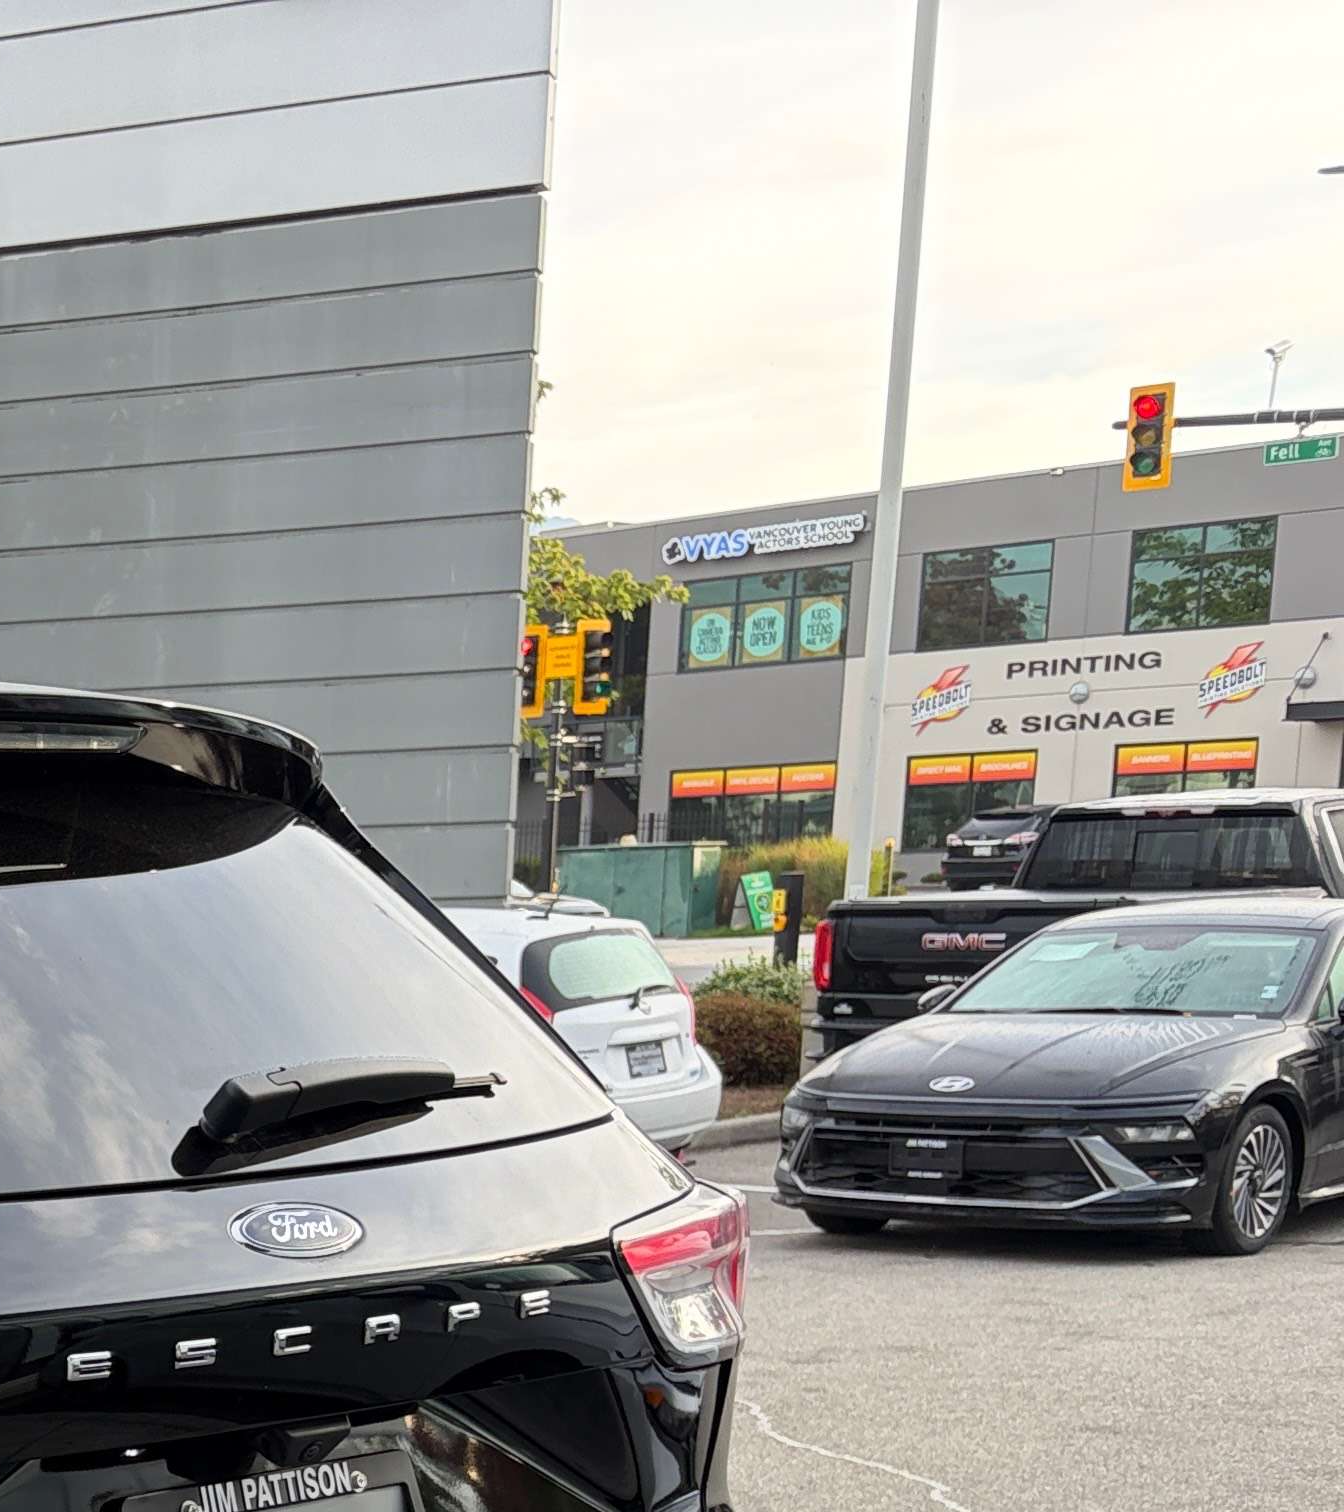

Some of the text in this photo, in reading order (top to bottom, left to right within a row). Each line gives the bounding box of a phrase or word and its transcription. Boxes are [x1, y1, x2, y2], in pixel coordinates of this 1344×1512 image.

[1269, 443, 1300, 461] Fell
[748, 517, 861, 540] VANCOUVER YOUNG
[756, 530, 851, 550] ACTORS SCHOOL
[683, 530, 746, 558] VYAS
[752, 615, 776, 631] NOW
[749, 631, 778, 648] OPEN
[1006, 651, 1162, 680] PRINTING
[1198, 660, 1267, 698] SPEEDBOLT
[911, 683, 972, 717] SPEEDBOLT
[987, 707, 1176, 735] & SIGNAGE
[921, 932, 1007, 951] GMC
[268, 1210, 338, 1243] Ford
[67, 1289, 551, 1383] ESCAPE
[242, 1461, 353, 1510] PATTISON
